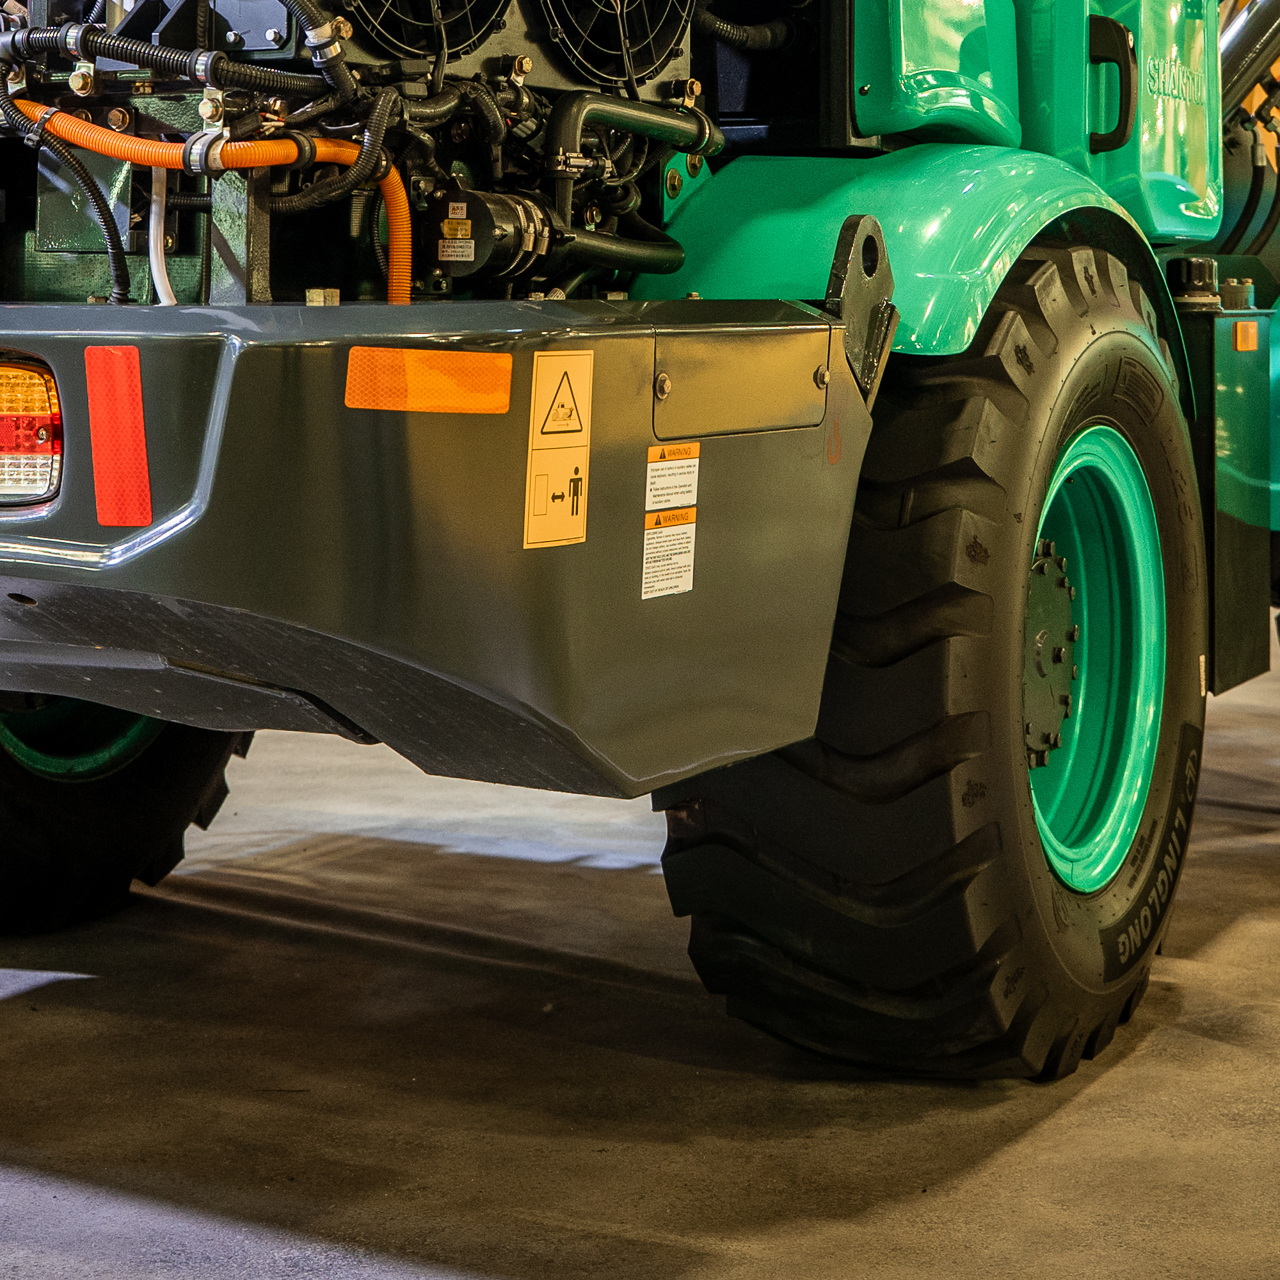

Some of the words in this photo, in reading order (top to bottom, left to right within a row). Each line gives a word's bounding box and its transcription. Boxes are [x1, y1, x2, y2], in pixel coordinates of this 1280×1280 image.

[667, 447, 692, 457] WARNING
[662, 513, 689, 524] WARNING
[1117, 807, 1188, 964] LINGLONG
